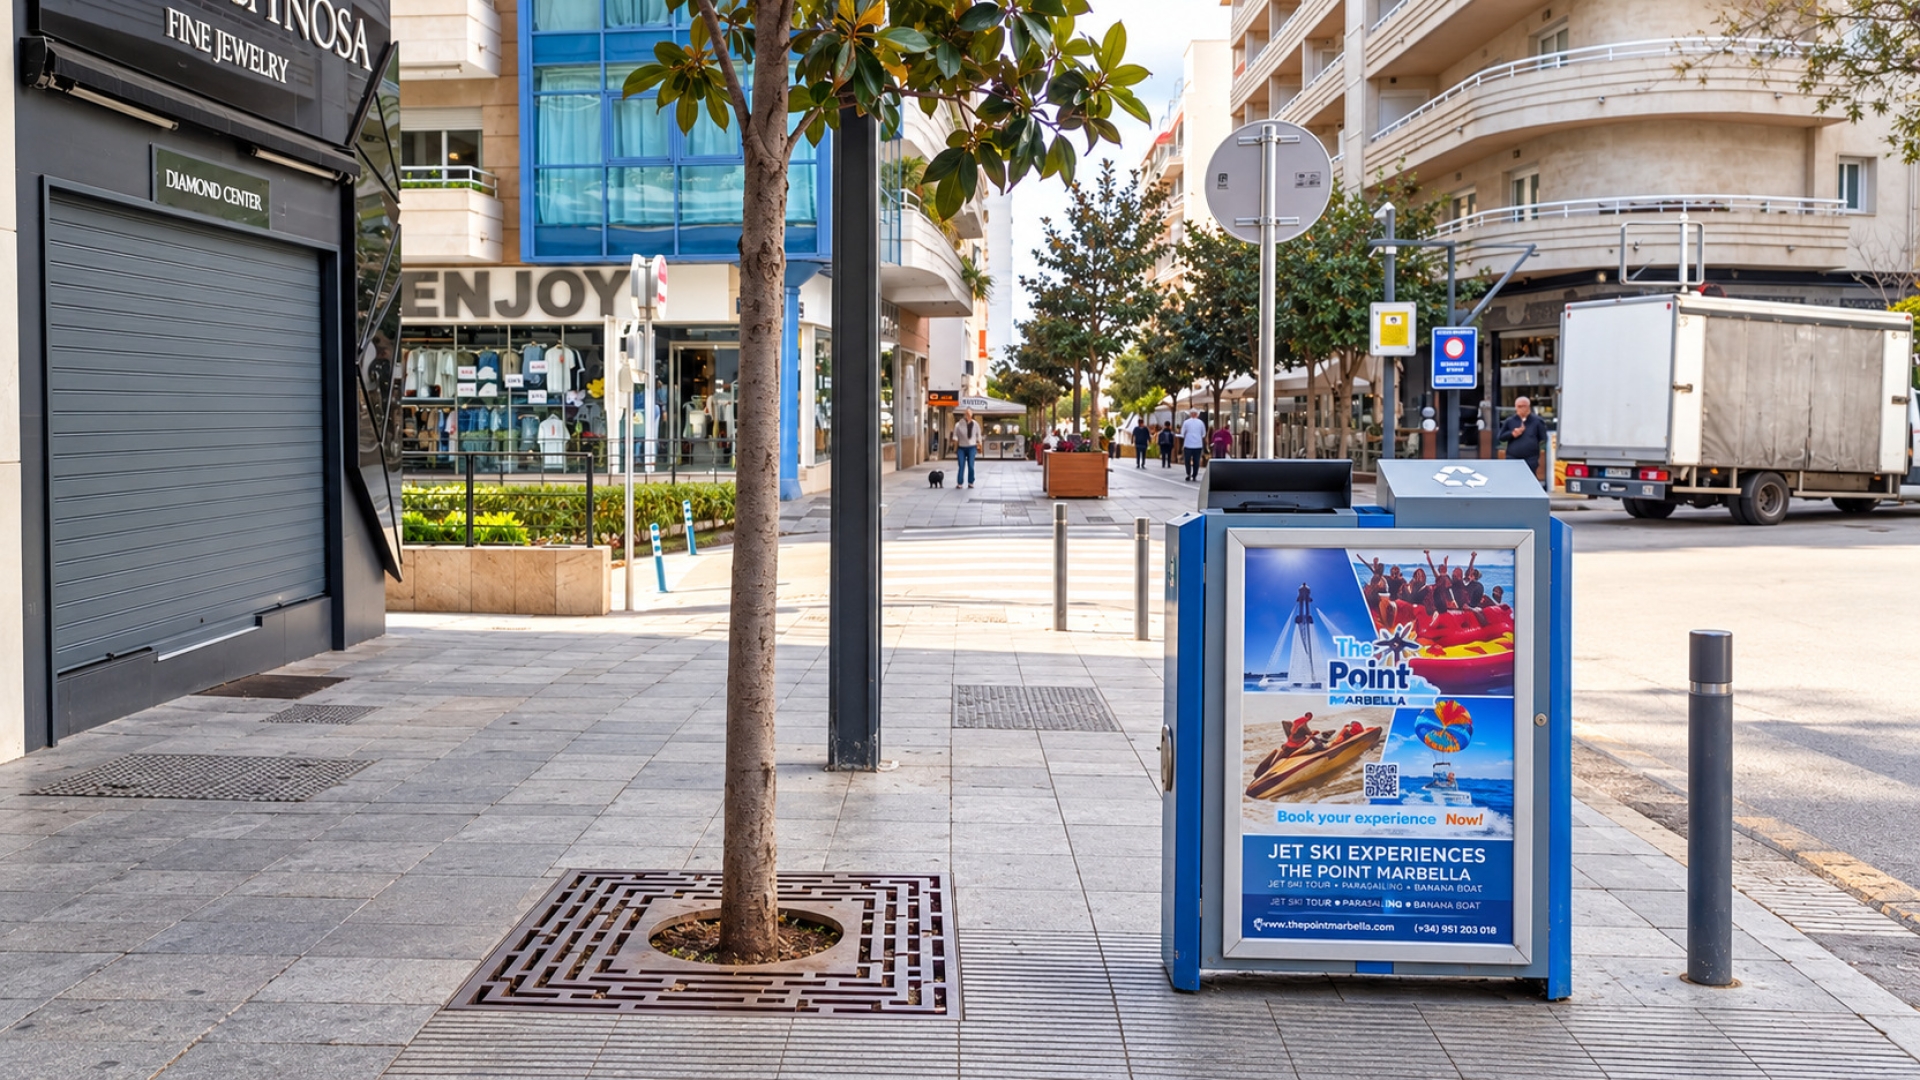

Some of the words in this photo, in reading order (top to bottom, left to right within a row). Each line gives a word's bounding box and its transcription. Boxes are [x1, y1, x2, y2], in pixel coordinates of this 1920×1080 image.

[166, 7, 211, 53] FINE
[213, 28, 289, 84] JEWELRY
[165, 169, 221, 200] DIAMOND
[223, 186, 262, 211] CENTER
[402, 270, 630, 318] ENJOY
[1335, 637, 1372, 657] The
[1329, 660, 1410, 689] Point
[1329, 695, 1406, 706] MARBELLA
[1277, 810, 1314, 823] Book
[1318, 813, 1351, 825] your
[1354, 812, 1437, 826] experience
[1445, 813, 1483, 826] Now!
[1268, 843, 1304, 859] JET
[1310, 844, 1341, 860] SKI
[1348, 845, 1486, 863] EXPERIENCES
[1278, 864, 1312, 877] THE
[1318, 865, 1372, 879] POINT
[1377, 866, 1471, 881] MARBELLA
[1268, 880, 1285, 888] JET
[1305, 898, 1332, 907] TOUR
[1456, 901, 1482, 909] BOAT
[1441, 925, 1458, 934] 951
[1460, 925, 1478, 934] 203
[1480, 926, 1497, 935] 018
